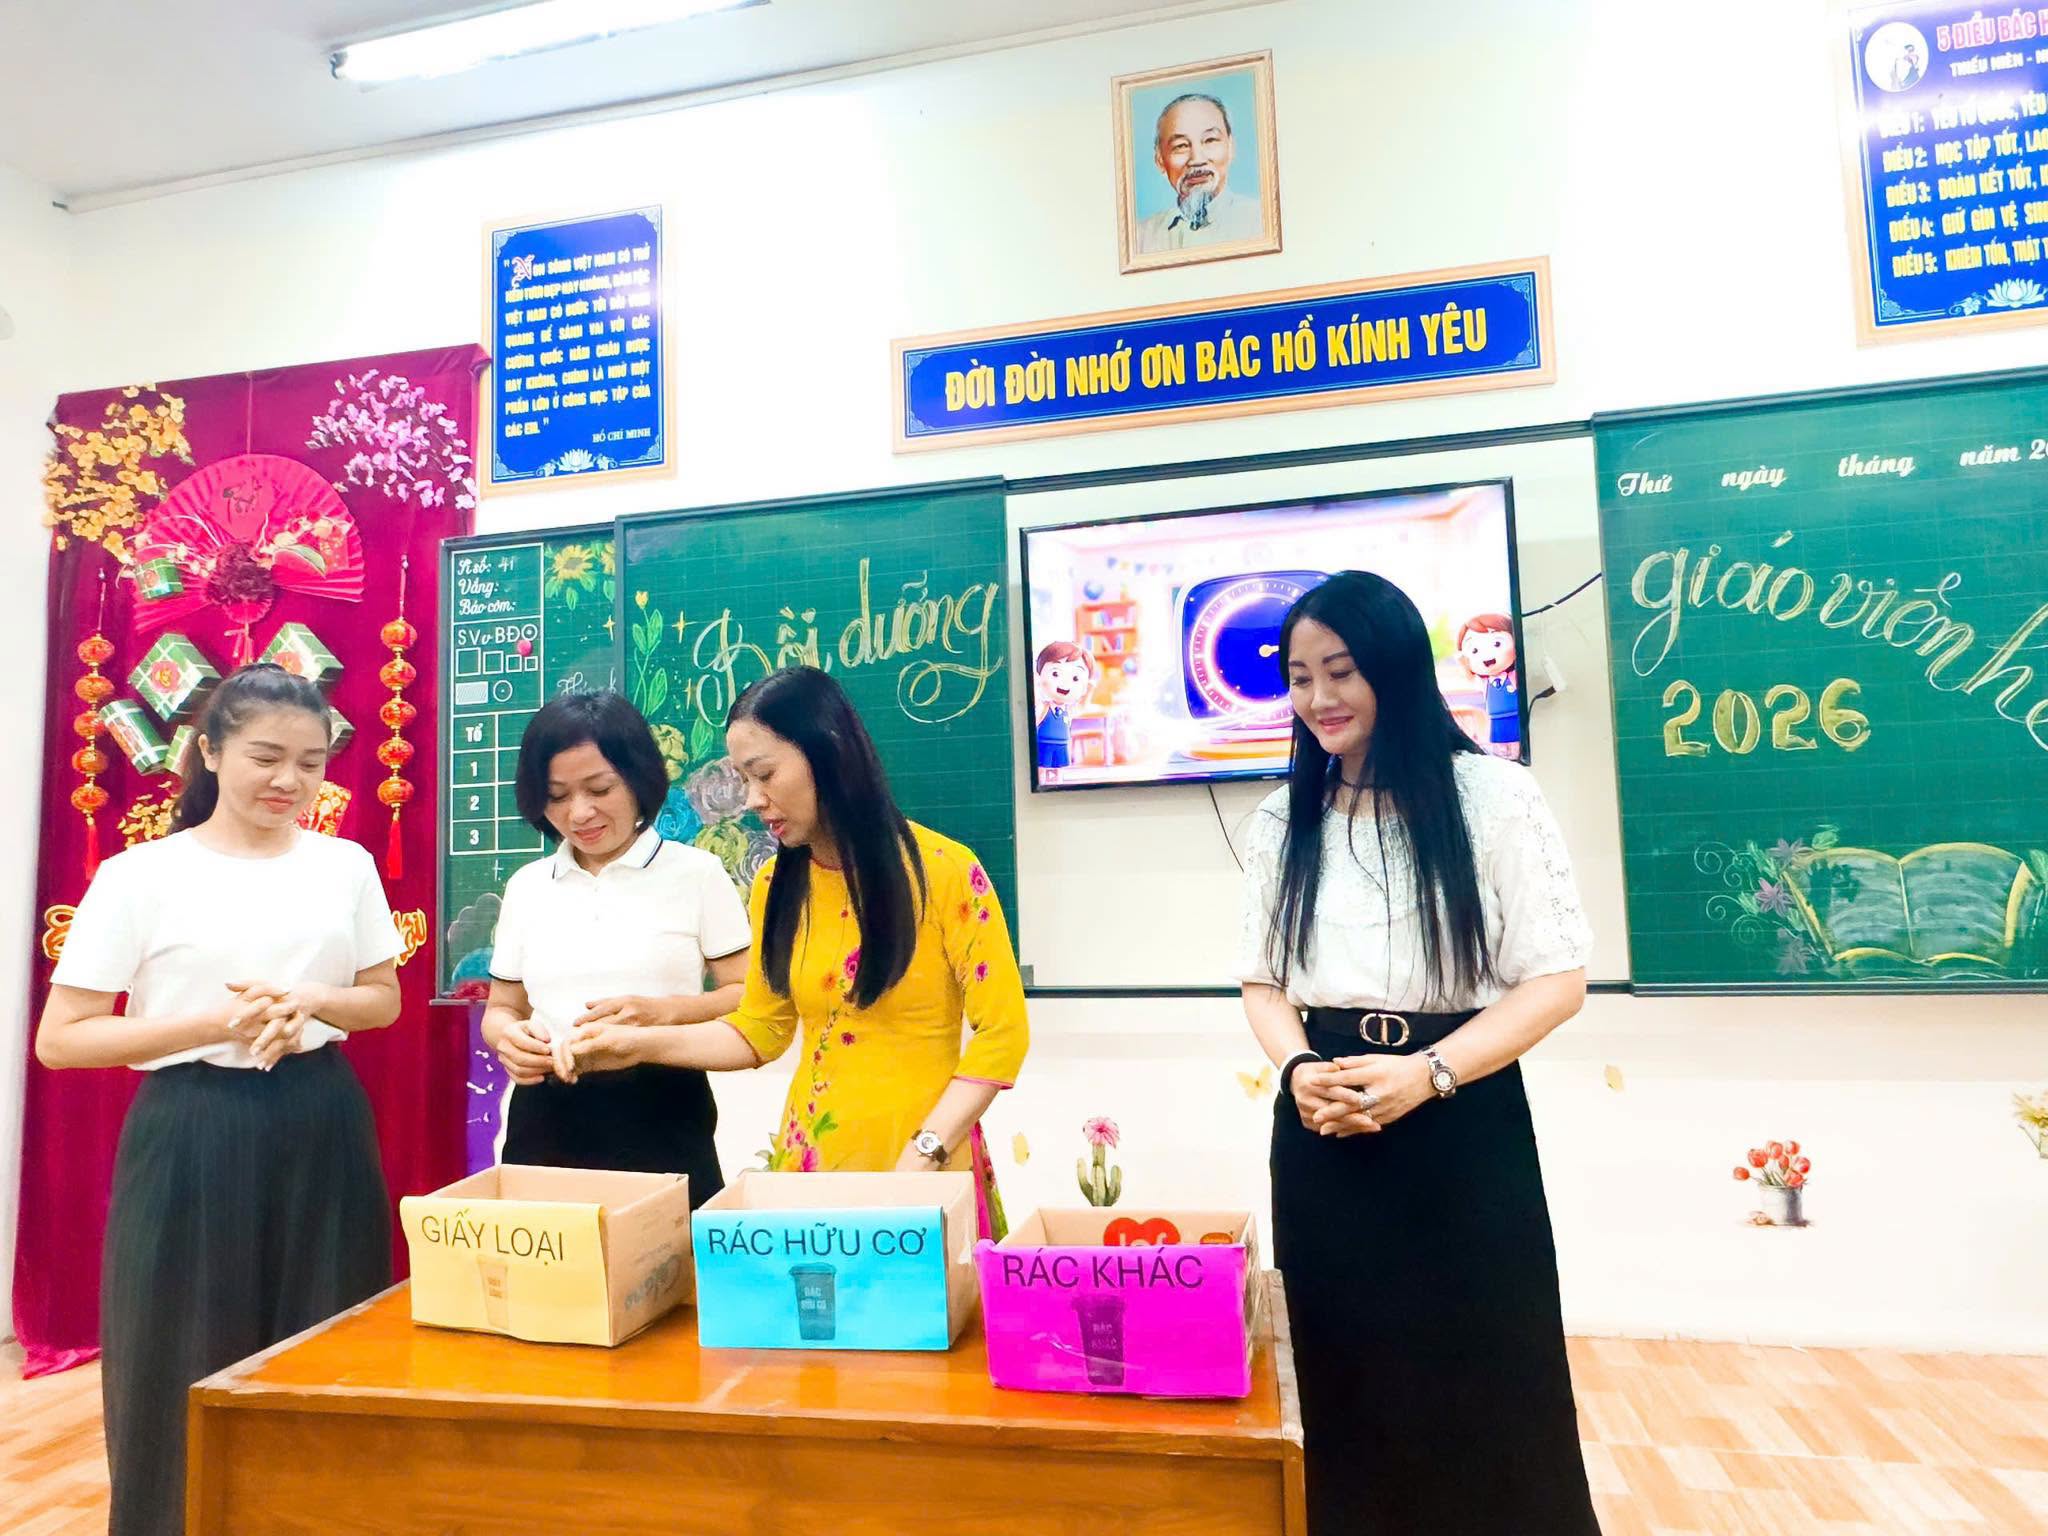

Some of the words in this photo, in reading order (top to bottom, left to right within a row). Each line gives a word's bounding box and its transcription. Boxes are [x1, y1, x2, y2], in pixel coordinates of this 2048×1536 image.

[1936, 25, 1951, 52] 5
[1935, 141, 1963, 168] HỌC
[1965, 133, 1991, 165] TẬP
[1994, 126, 2023, 156] TỐT,
[2007, 160, 2037, 191] TỐT,
[2000, 200, 2019, 232] VỆ
[945, 358, 996, 412] ĐỜI
[1004, 351, 1056, 405] ĐỜI
[1066, 339, 1132, 398] NHỚ
[1141, 343, 1186, 388] ƠN
[1195, 329, 1261, 383] BÁC
[1272, 313, 1316, 374] HỒ
[1327, 313, 1411, 368] KÍNH
[1420, 302, 1487, 357] YÊU
[626, 428, 650, 439] MINH
[1617, 472, 1673, 496] Thứ
[1721, 465, 1787, 491] ngày
[1838, 453, 1915, 478] tháng
[1959, 444, 2021, 466] năm
[2029, 438, 2047, 460] 2
[458, 578, 499, 598] Vắng:
[459, 599, 487, 615] Báo
[1631, 530, 1814, 677] giáo
[1819, 572, 1976, 692] viên
[838, 557, 1003, 724] dưỡng
[465, 723, 483, 742] Tổ
[1662, 678, 1871, 758] 2026
[470, 761, 478, 777] 1
[470, 795, 480, 811] 2
[469, 829, 480, 845] 3
[421, 1208, 485, 1249] GIẤY
[495, 1225, 564, 1266] LOẠI
[708, 1221, 774, 1256] RÁC
[784, 1222, 860, 1256] HỮU
[872, 1227, 927, 1256] CƠ
[1002, 1247, 1079, 1289] RÁC
[1092, 1246, 1204, 1289] KHÁC
